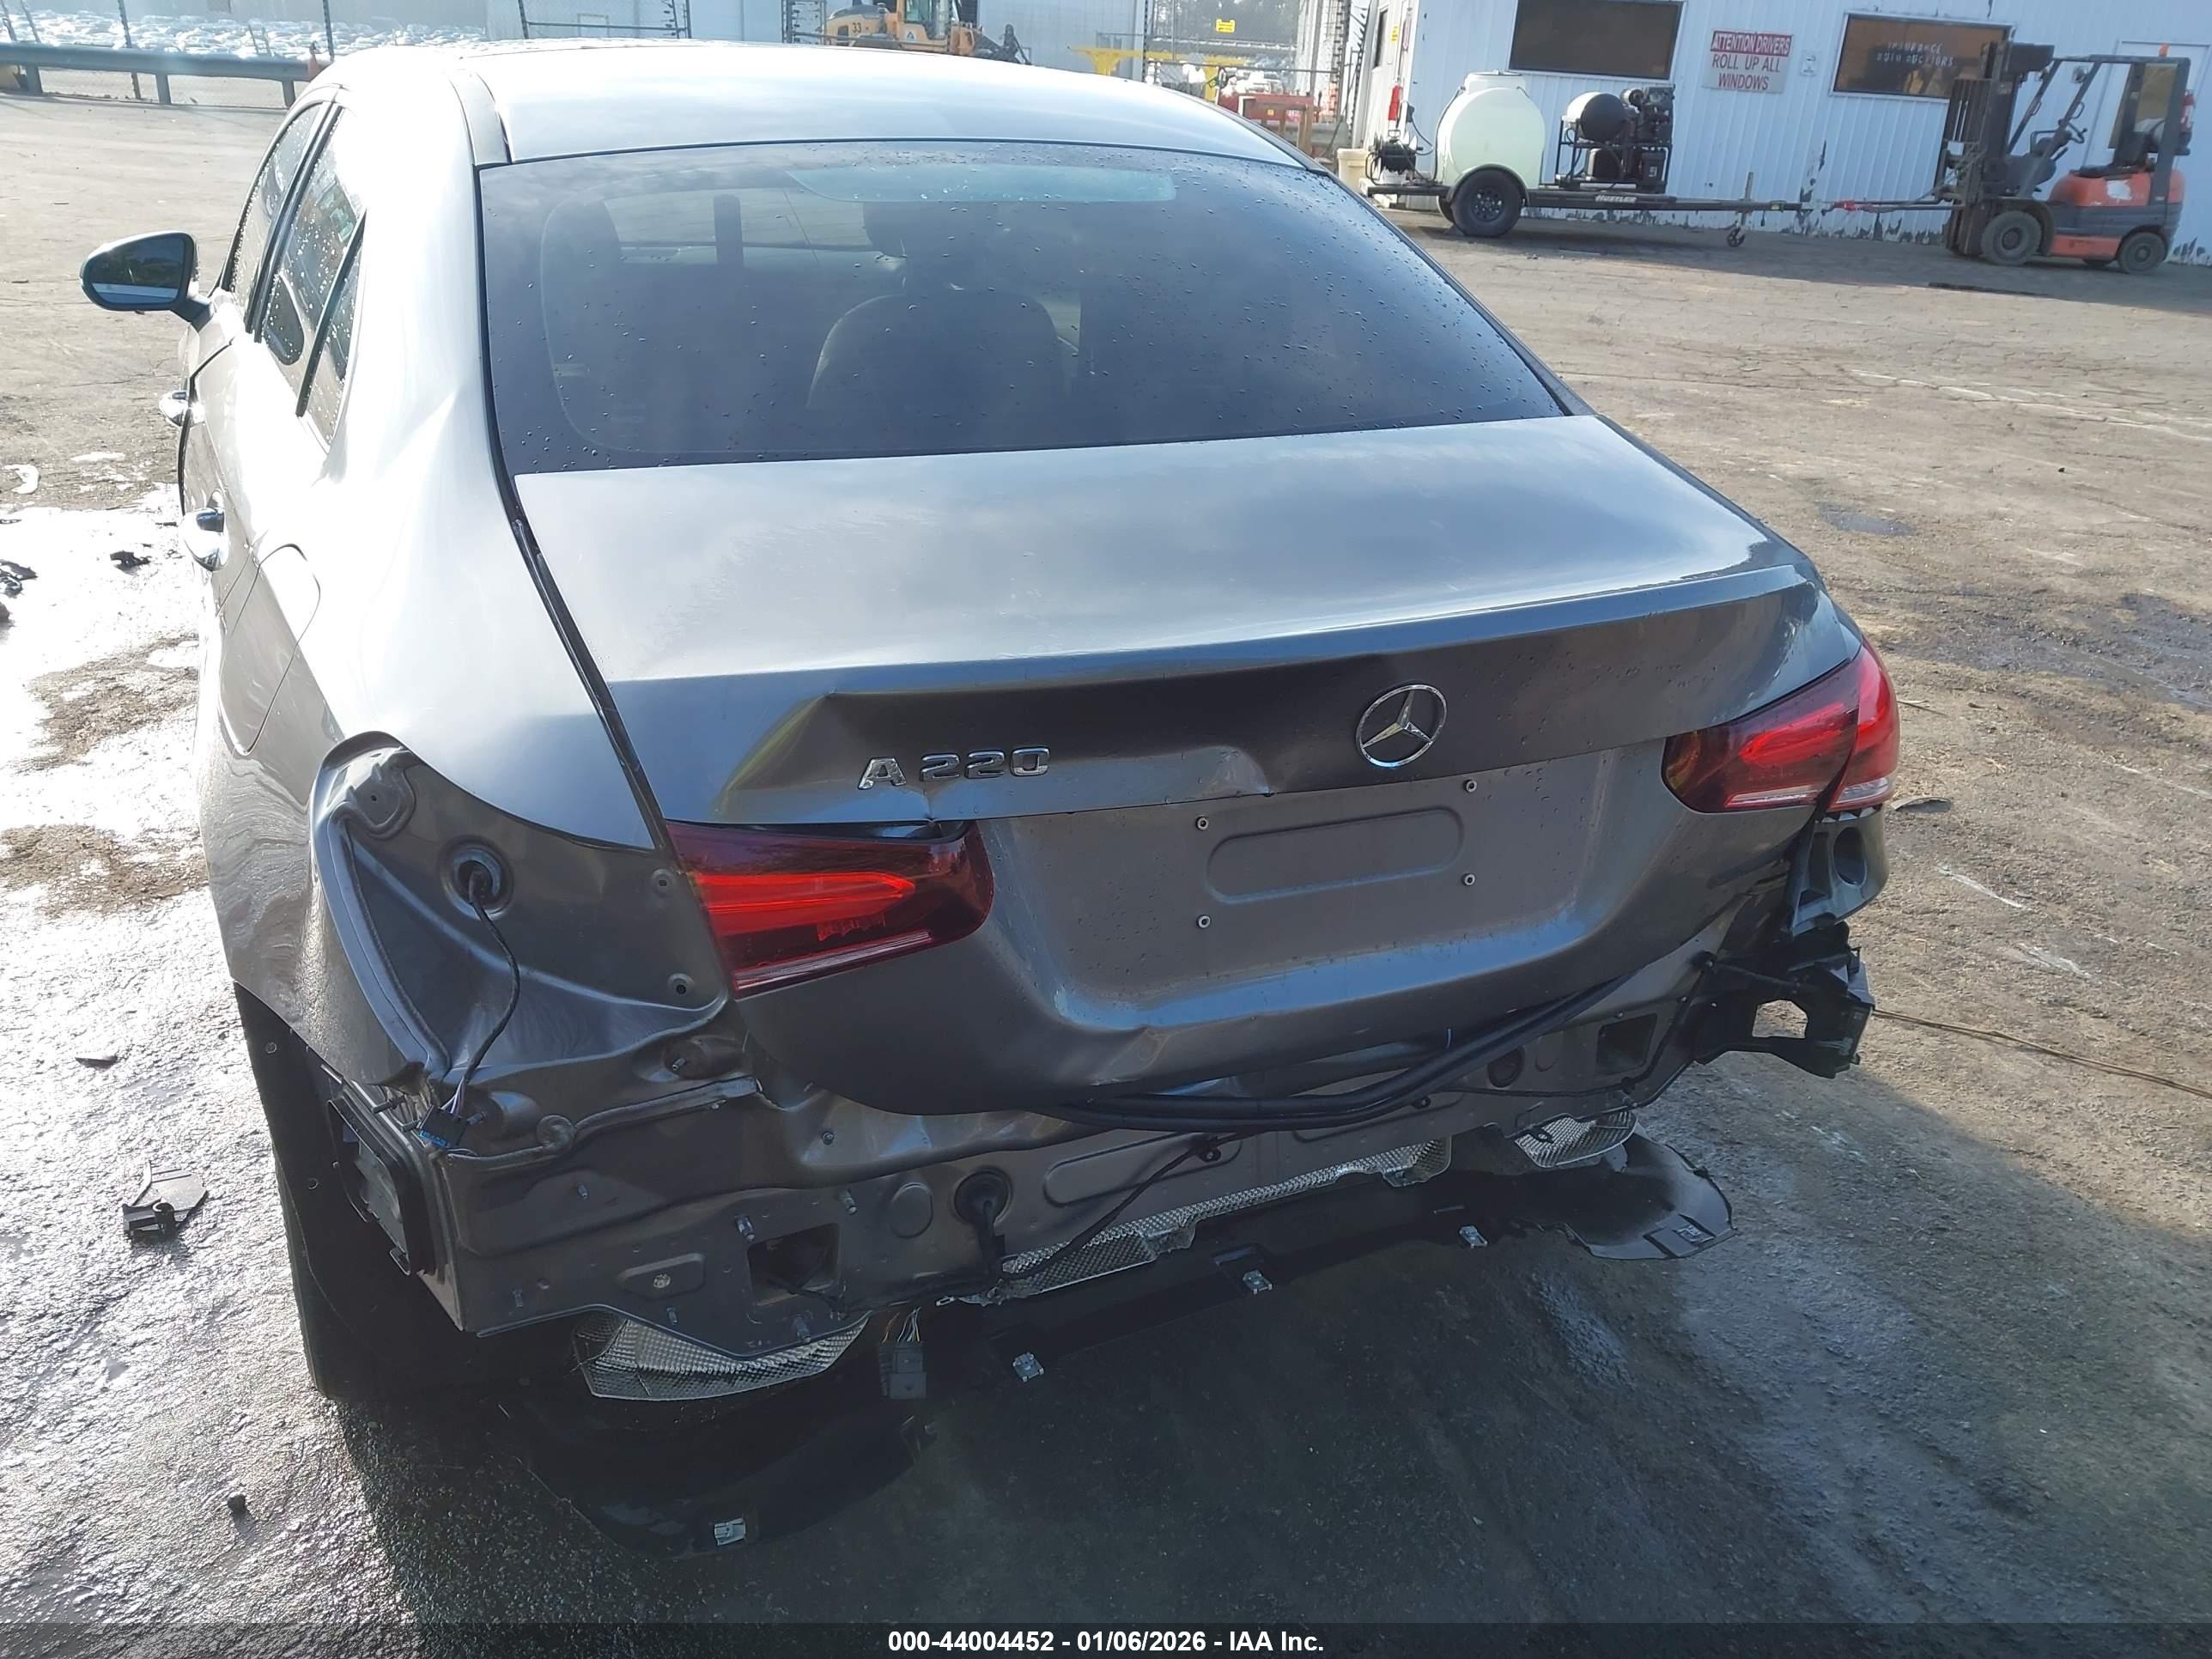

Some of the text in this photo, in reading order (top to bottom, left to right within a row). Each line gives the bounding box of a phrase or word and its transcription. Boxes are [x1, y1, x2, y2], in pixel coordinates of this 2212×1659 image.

[852, 22, 861, 33] 33
[1712, 33, 1790, 55] ATTENTION DRIVERS
[1712, 53, 1780, 72] ROLL UP ALL
[1718, 73, 1770, 90] WINDOWS
[858, 746, 1050, 790] A 220
